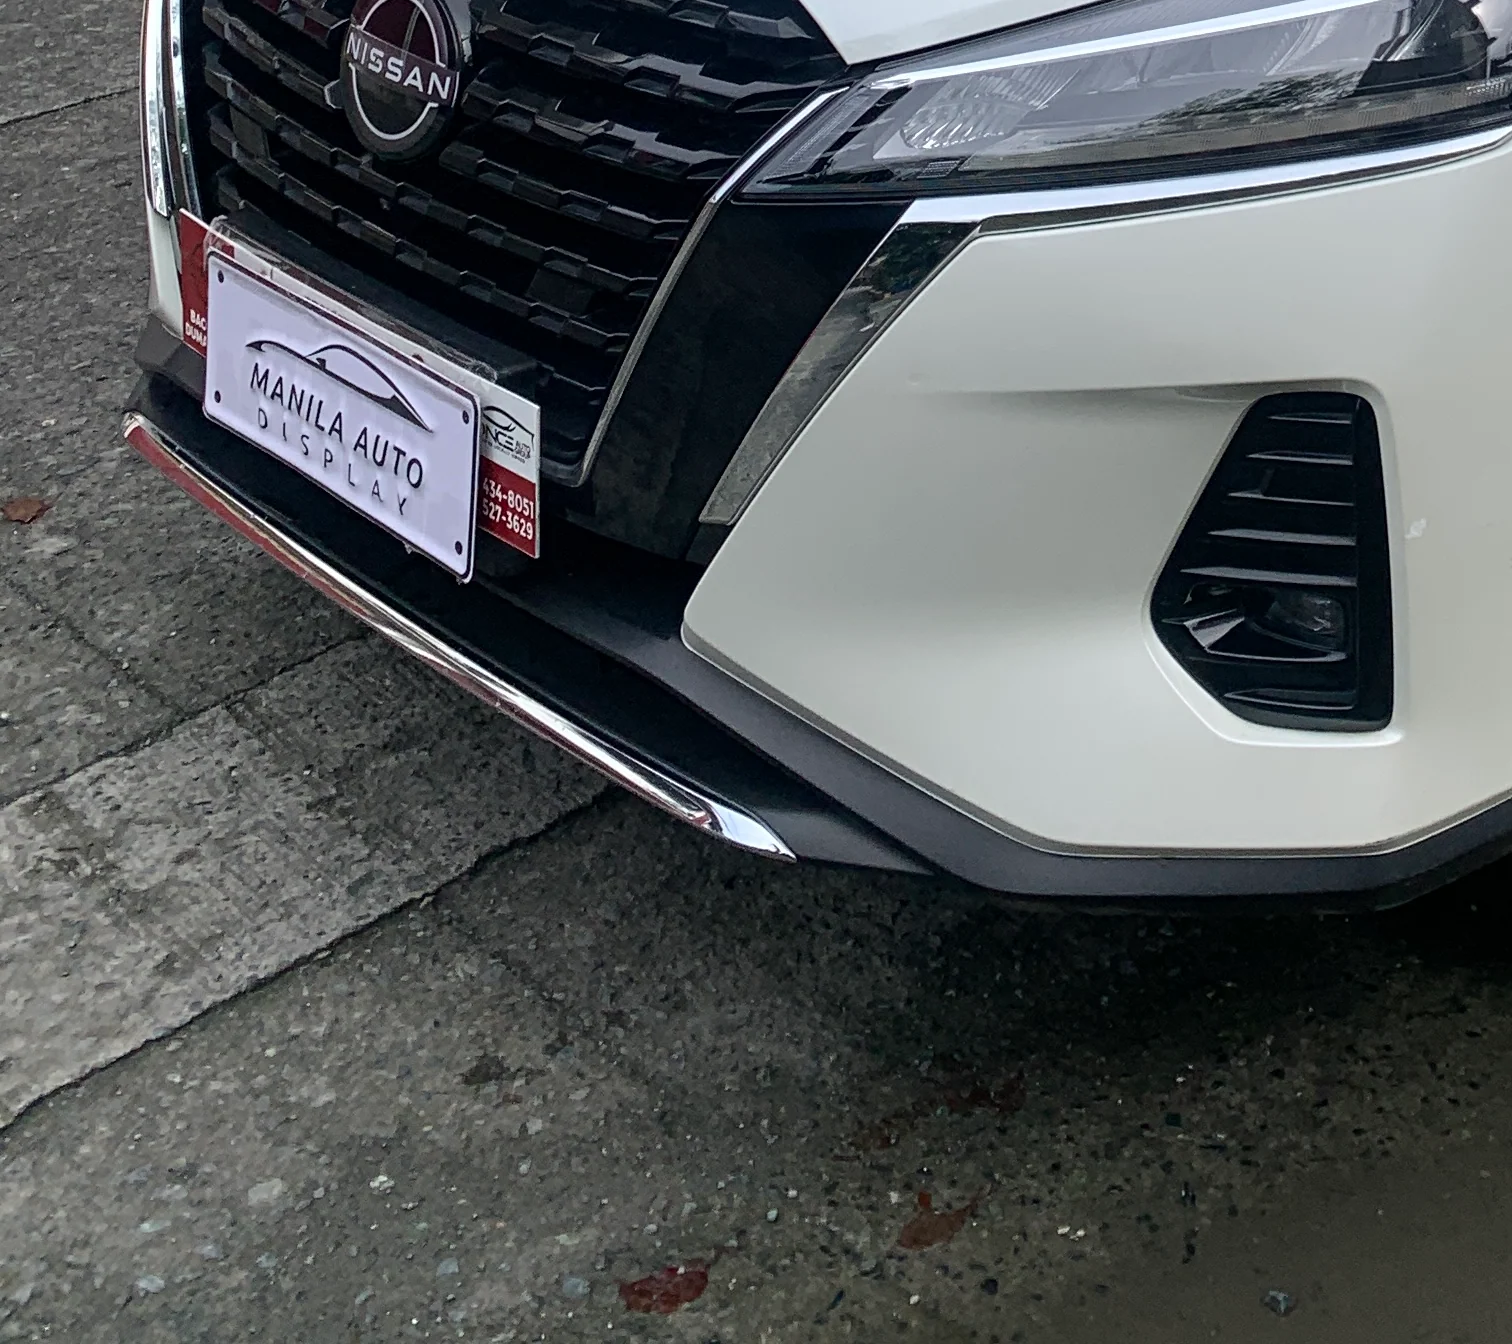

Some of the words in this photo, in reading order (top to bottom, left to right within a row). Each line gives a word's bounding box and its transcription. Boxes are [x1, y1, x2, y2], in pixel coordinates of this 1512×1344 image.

[346, 31, 451, 101] NISSAN
[250, 362, 345, 444] MANILA
[353, 426, 423, 490] AUTO
[258, 407, 408, 516] DISPLAY
[482, 477, 534, 520] 434-8051
[482, 499, 534, 541] 527-3629
